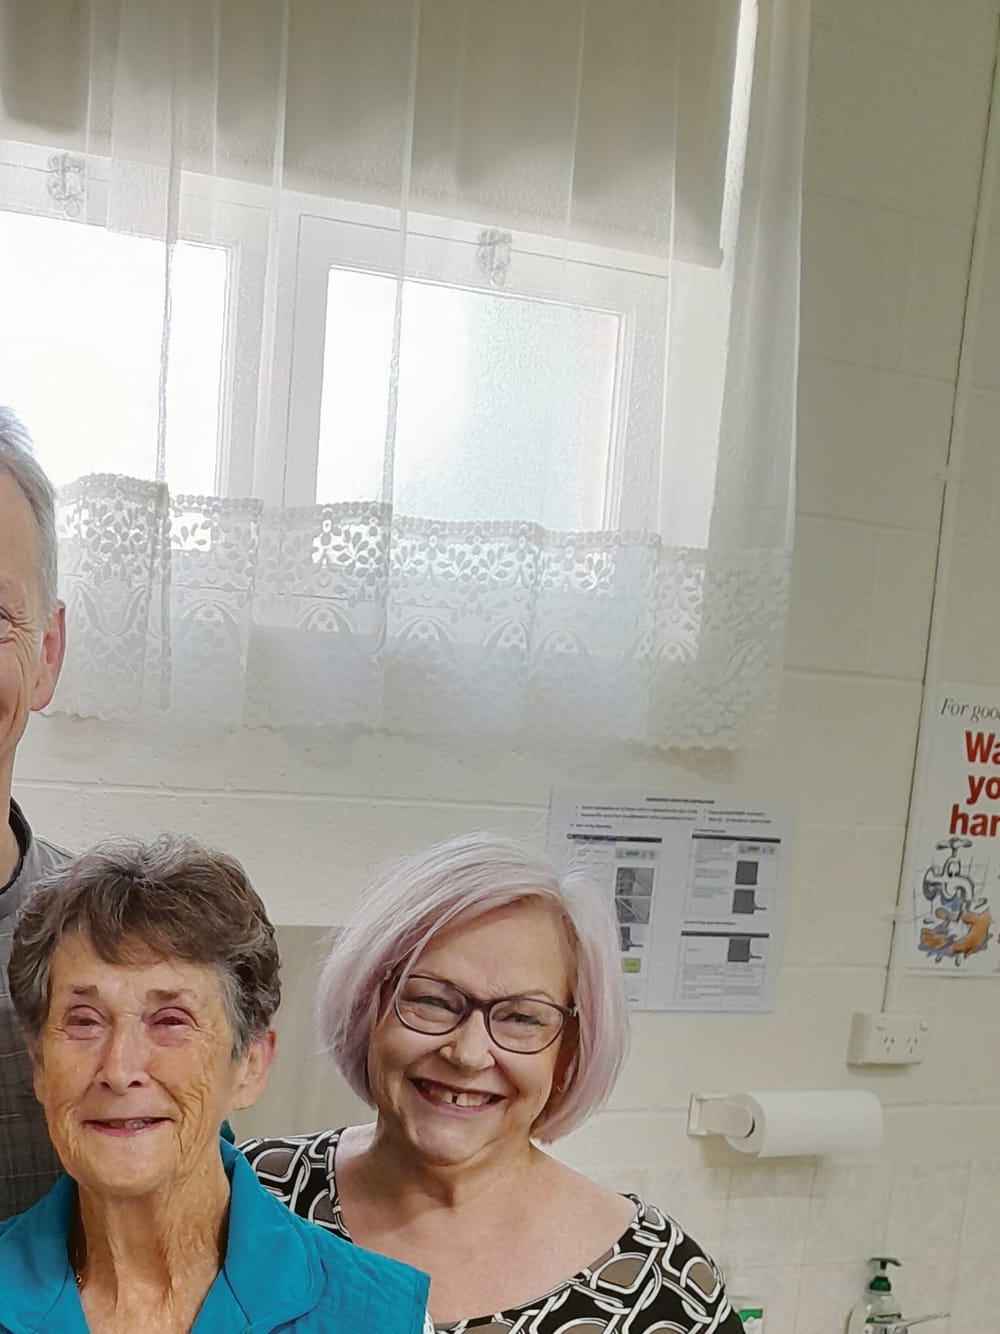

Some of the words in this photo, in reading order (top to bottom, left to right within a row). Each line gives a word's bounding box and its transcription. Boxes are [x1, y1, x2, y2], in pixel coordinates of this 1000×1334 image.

[941, 698, 969, 716] For
[970, 704, 1000, 723] goo
[966, 775, 1000, 804] yo
